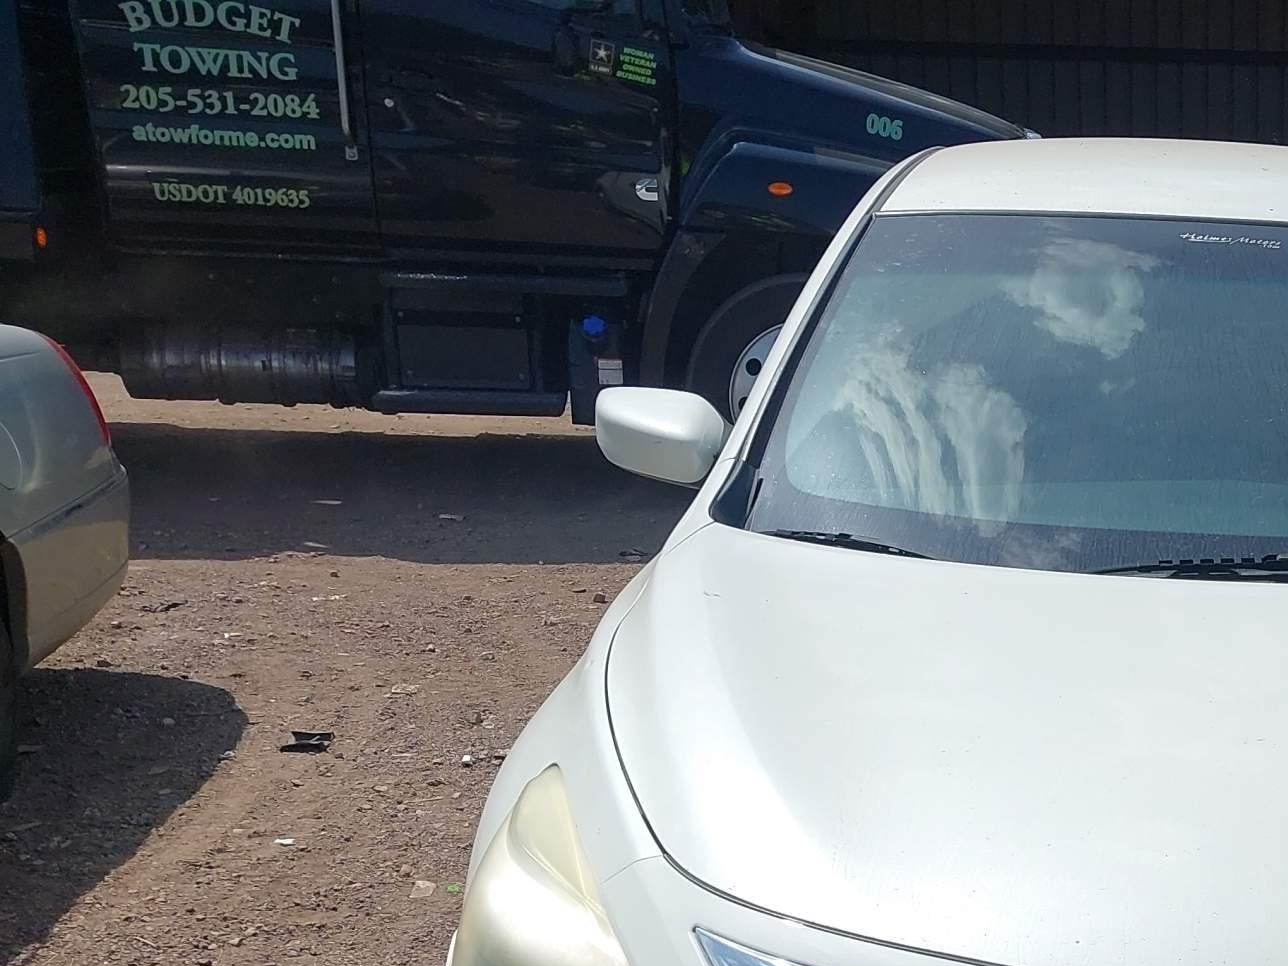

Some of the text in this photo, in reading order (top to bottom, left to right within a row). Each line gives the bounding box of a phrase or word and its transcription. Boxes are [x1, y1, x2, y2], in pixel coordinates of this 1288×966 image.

[118, 0, 301, 44] BUDGET
[133, 42, 299, 80] TOWING
[620, 54, 657, 69] VETERAN
[622, 63, 652, 76] OWNED
[616, 70, 657, 85] BUSINESS
[120, 84, 320, 119] 205-531-2084
[132, 122, 317, 150] atowforme.com
[866, 113, 903, 140] 006
[152, 182, 311, 209] USDOT 4019635
